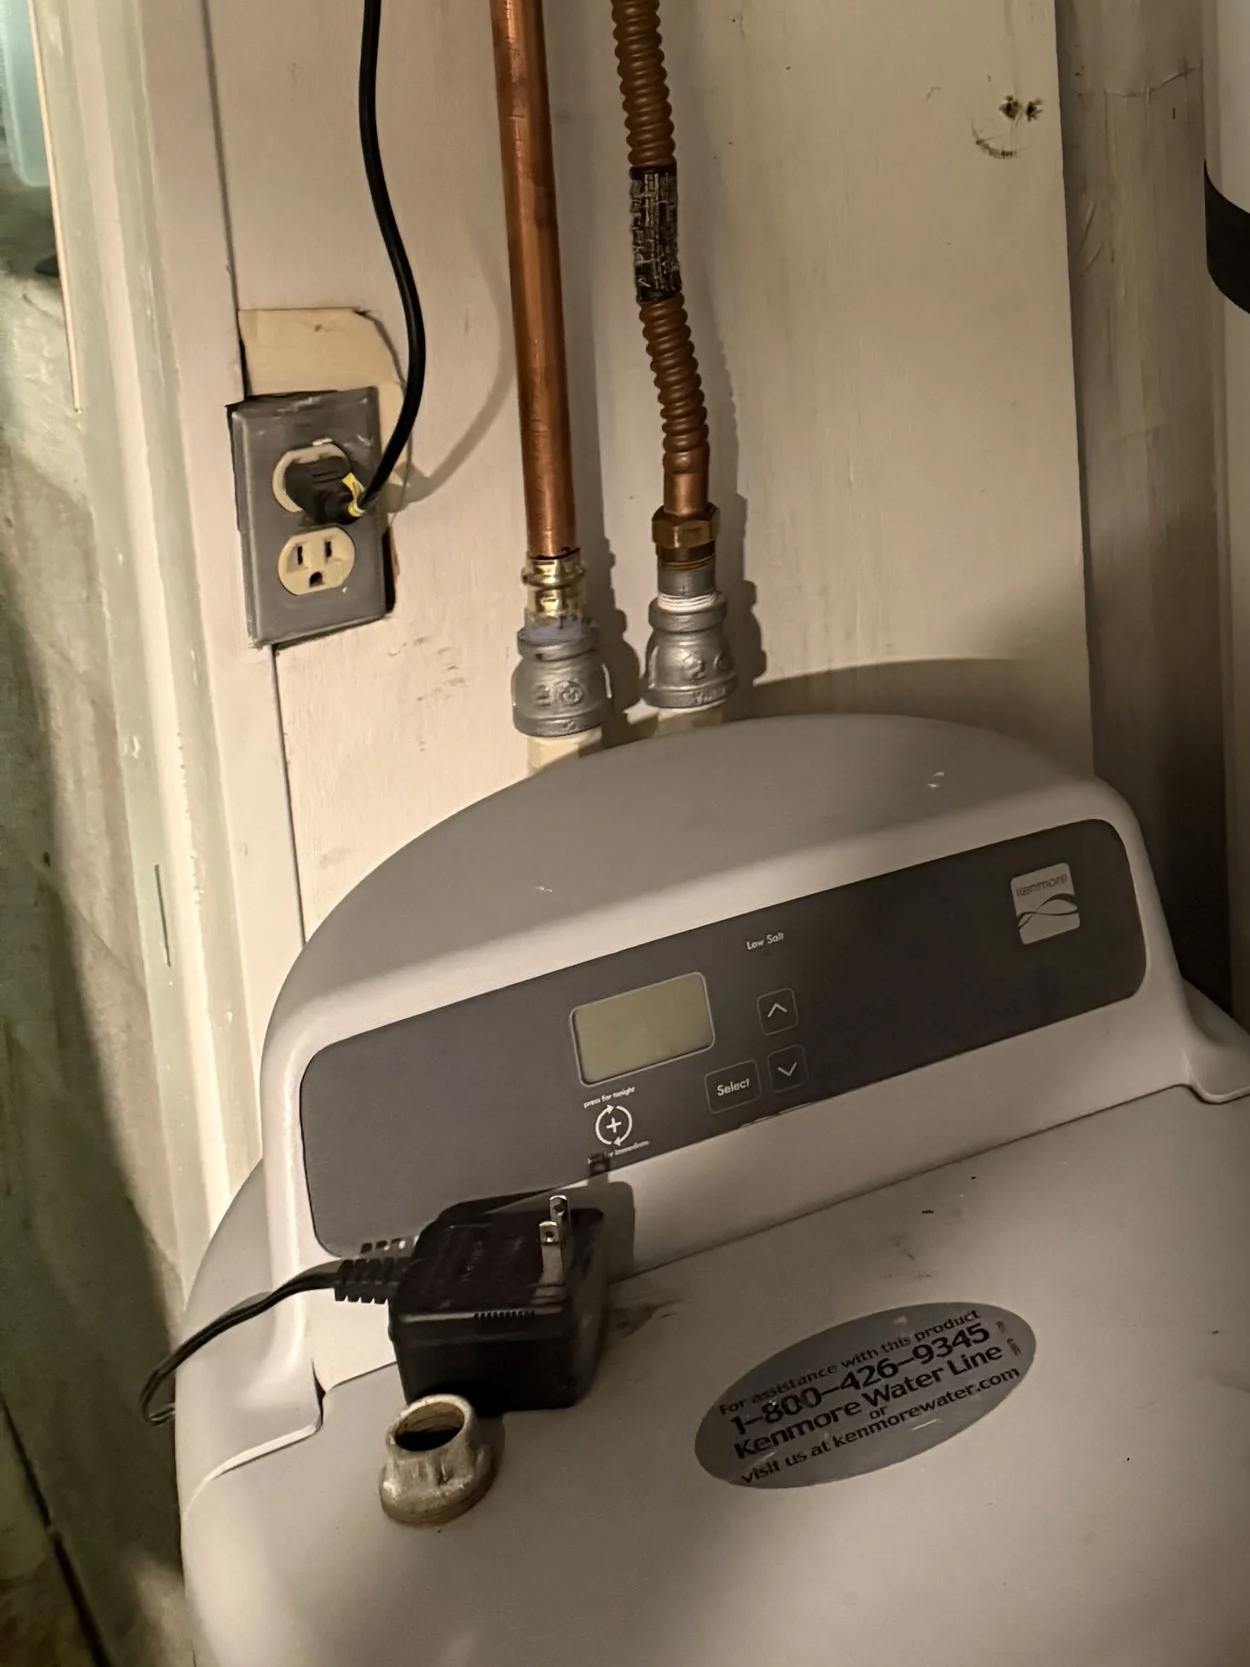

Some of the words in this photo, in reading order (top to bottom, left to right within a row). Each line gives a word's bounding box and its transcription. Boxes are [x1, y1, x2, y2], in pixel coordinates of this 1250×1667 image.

[746, 939, 765, 950] Low
[766, 932, 784, 944] Salt
[716, 1077, 750, 1097] Select
[719, 1399, 745, 1415] For
[752, 1364, 838, 1403] assistance
[841, 1348, 880, 1368] with
[881, 1334, 912, 1354] this
[914, 1310, 983, 1343] product
[730, 1322, 990, 1436] 1-800-426-9345
[734, 1400, 862, 1460] Kenmore
[861, 1367, 945, 1408] Water
[947, 1345, 1003, 1376] Line
[869, 1405, 889, 1420] or
[741, 1459, 782, 1484] visit
[785, 1451, 808, 1467] us
[811, 1439, 832, 1457] at
[832, 1367, 1020, 1448] kenmorewater.com
